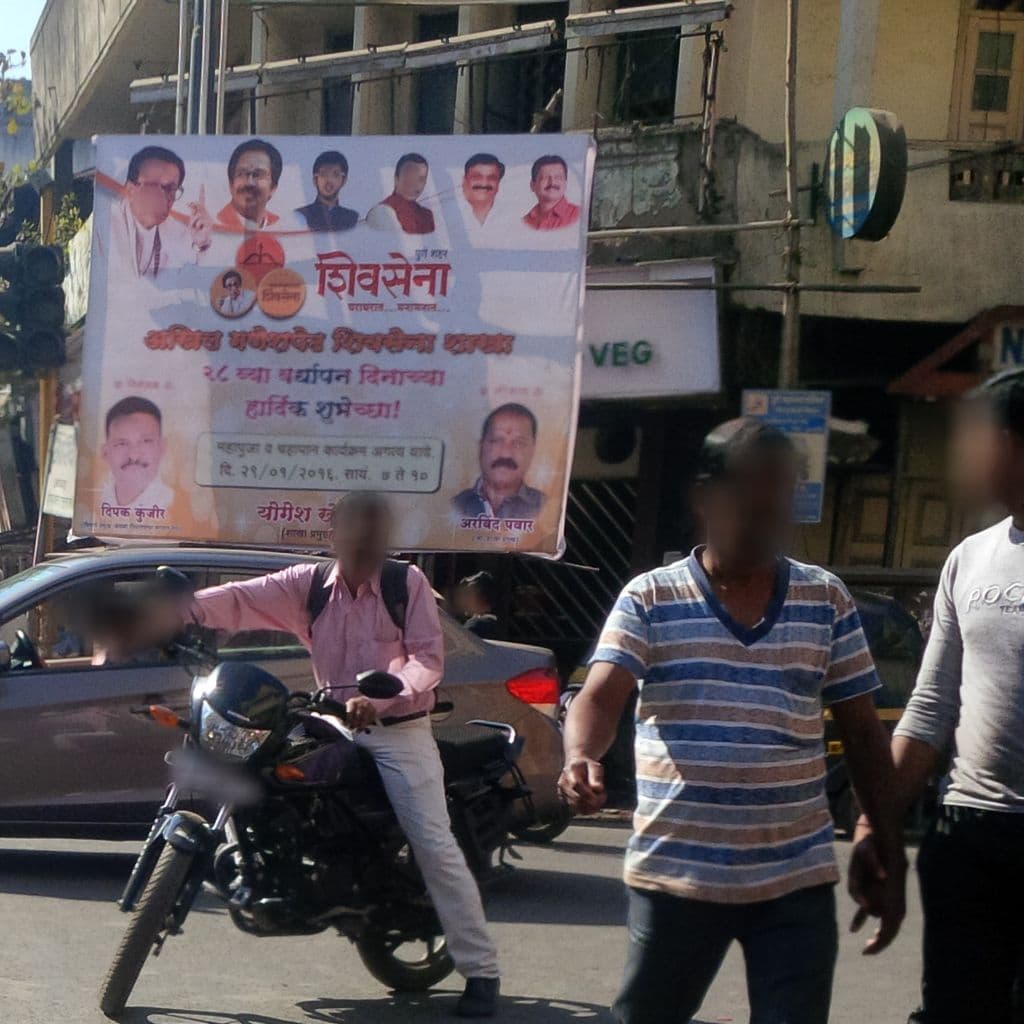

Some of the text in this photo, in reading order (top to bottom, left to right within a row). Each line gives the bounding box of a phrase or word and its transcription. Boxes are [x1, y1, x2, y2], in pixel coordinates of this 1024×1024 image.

[315, 250, 452, 300] शिवसेना
[332, 326, 436, 354] शिवसेना
[588, 340, 653, 368] VEG
[203, 365, 228, 382] २८
[236, 366, 272, 384] व्या
[359, 363, 446, 386] दिनाच्या
[245, 394, 310, 419] हार्दिक
[395, 466, 406, 481] ते
[101, 502, 131, 519] दिपक
[257, 501, 312, 523] योगेश
[505, 519, 535, 533] पवार
